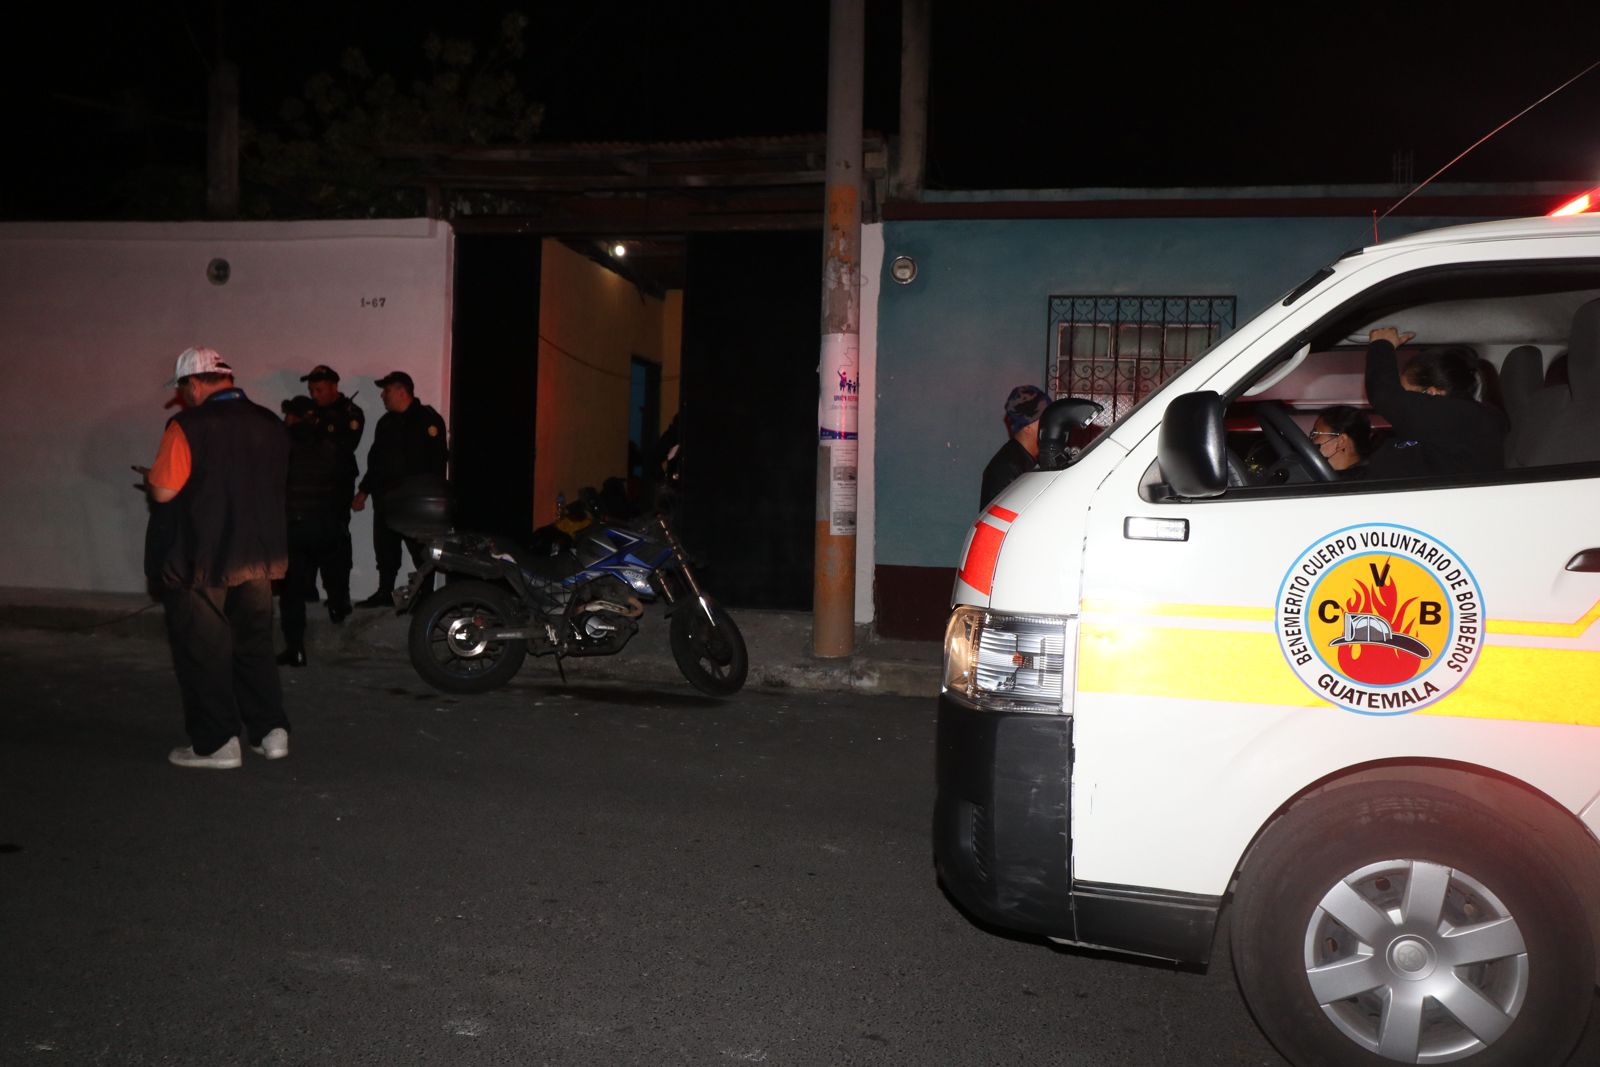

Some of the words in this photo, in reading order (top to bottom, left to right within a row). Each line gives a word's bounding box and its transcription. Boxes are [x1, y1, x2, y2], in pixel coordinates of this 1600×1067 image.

[361, 297, 386, 308] 1-67
[1303, 535, 1357, 576] CUERPO
[1360, 531, 1451, 572] VOLUNTARIO
[1318, 599, 1340, 624] C
[1369, 563, 1391, 587] V
[1419, 601, 1442, 625] B
[1445, 569, 1468, 590] DE
[1284, 575, 1312, 666] BENEMERITO
[1447, 591, 1478, 673] BOMBEROS
[1317, 673, 1440, 709] GUATEMALA
